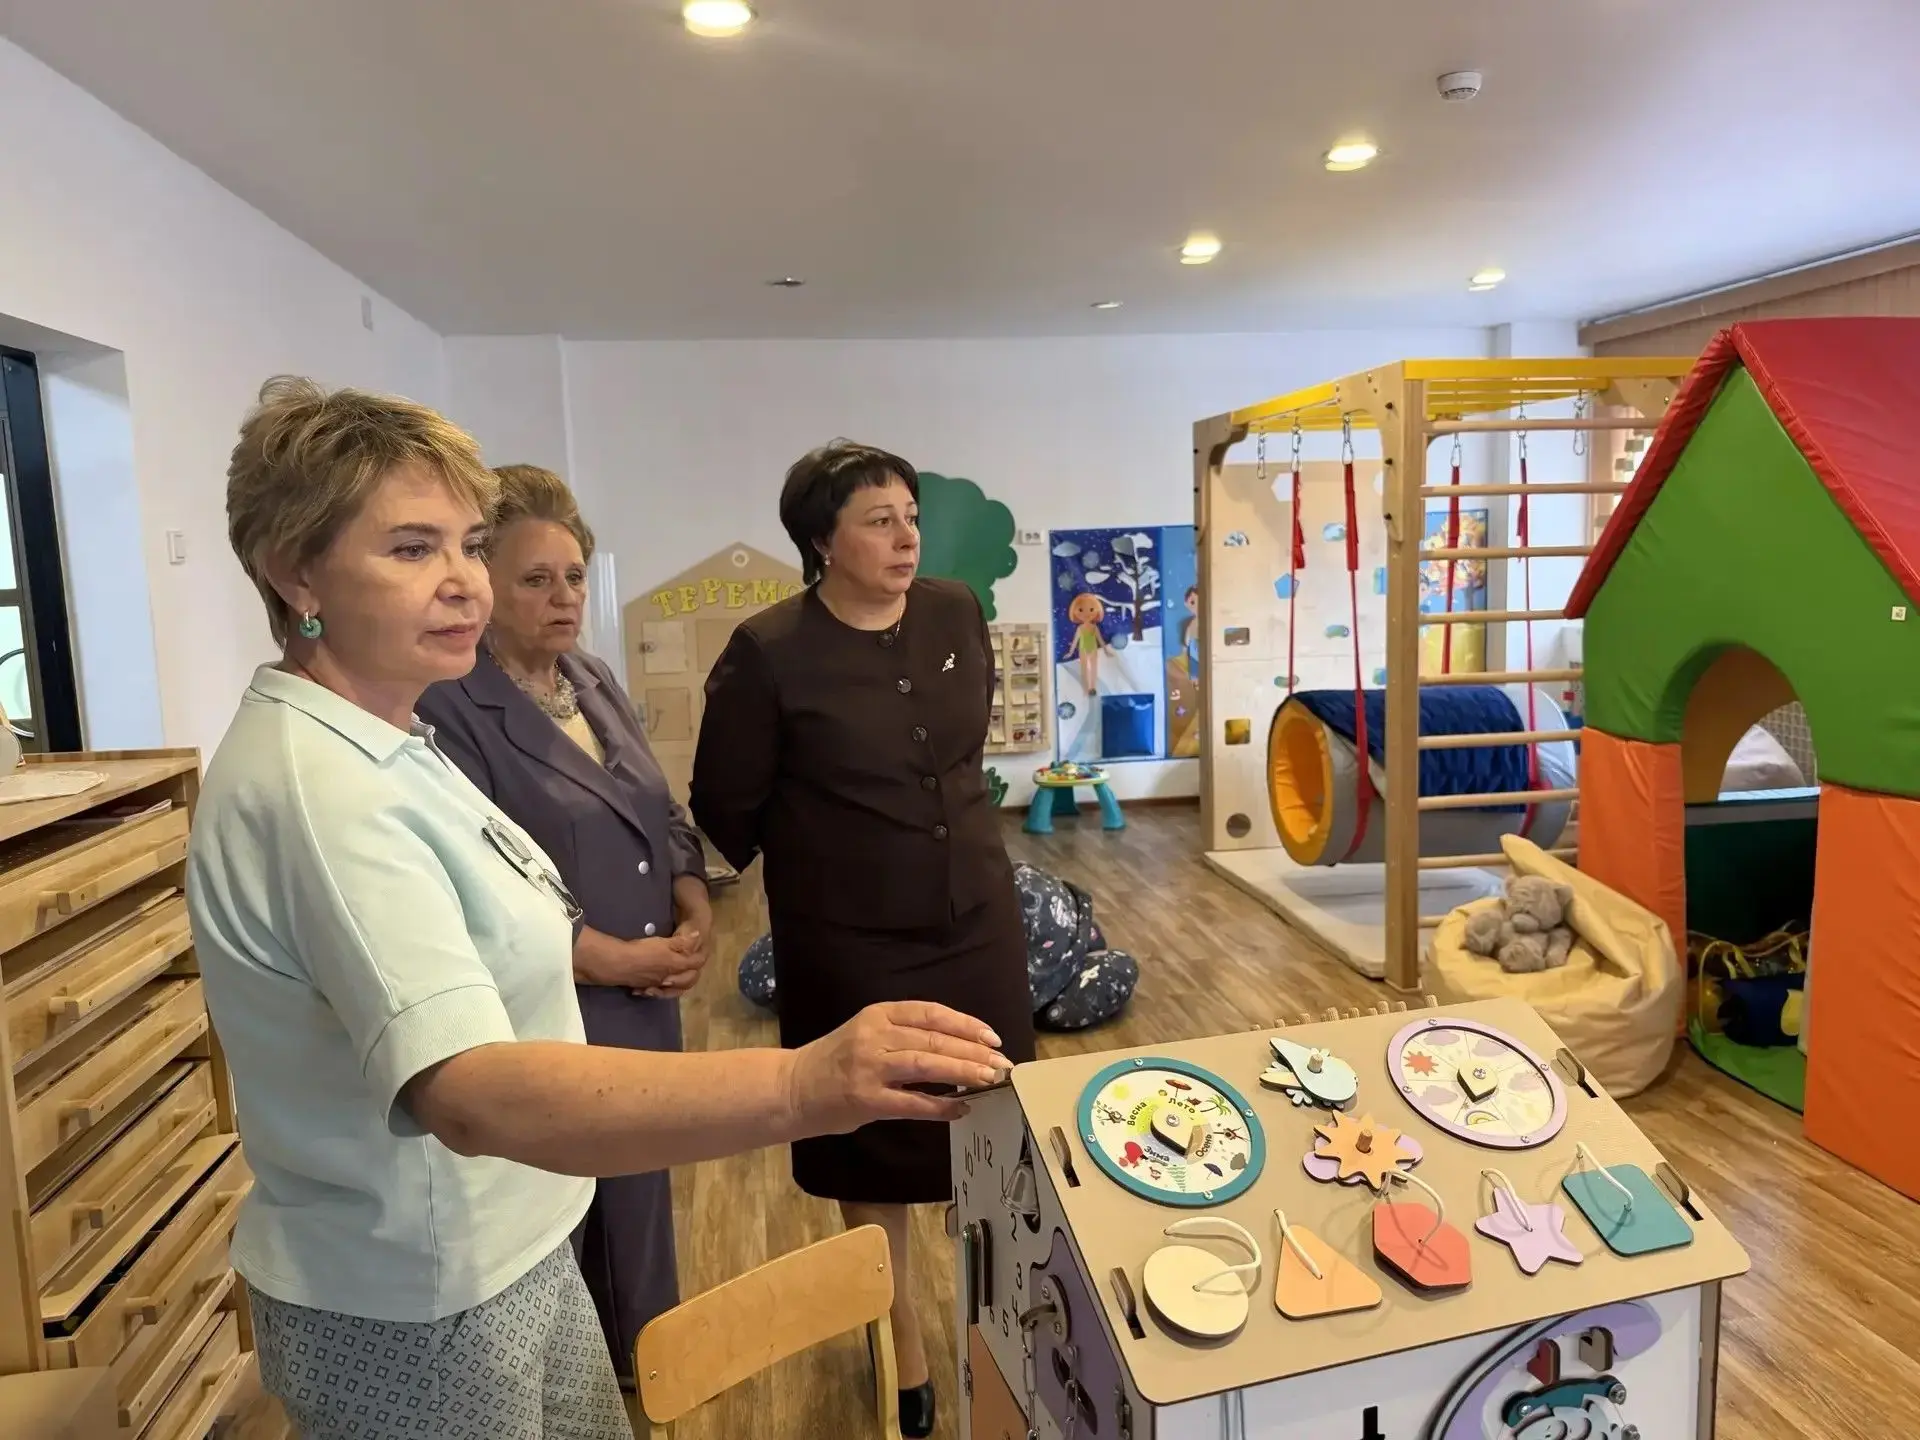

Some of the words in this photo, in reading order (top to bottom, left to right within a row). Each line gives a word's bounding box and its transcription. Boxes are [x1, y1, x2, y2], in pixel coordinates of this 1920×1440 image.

[1127, 1101, 1147, 1126] Весна
[1168, 1097, 1196, 1114] Лето
[983, 1134, 993, 1168] 12
[1143, 1145, 1171, 1162] Зима
[1195, 1133, 1213, 1158] Осень
[1010, 1211, 1018, 1242] 2
[1015, 1261, 1023, 1291] 3
